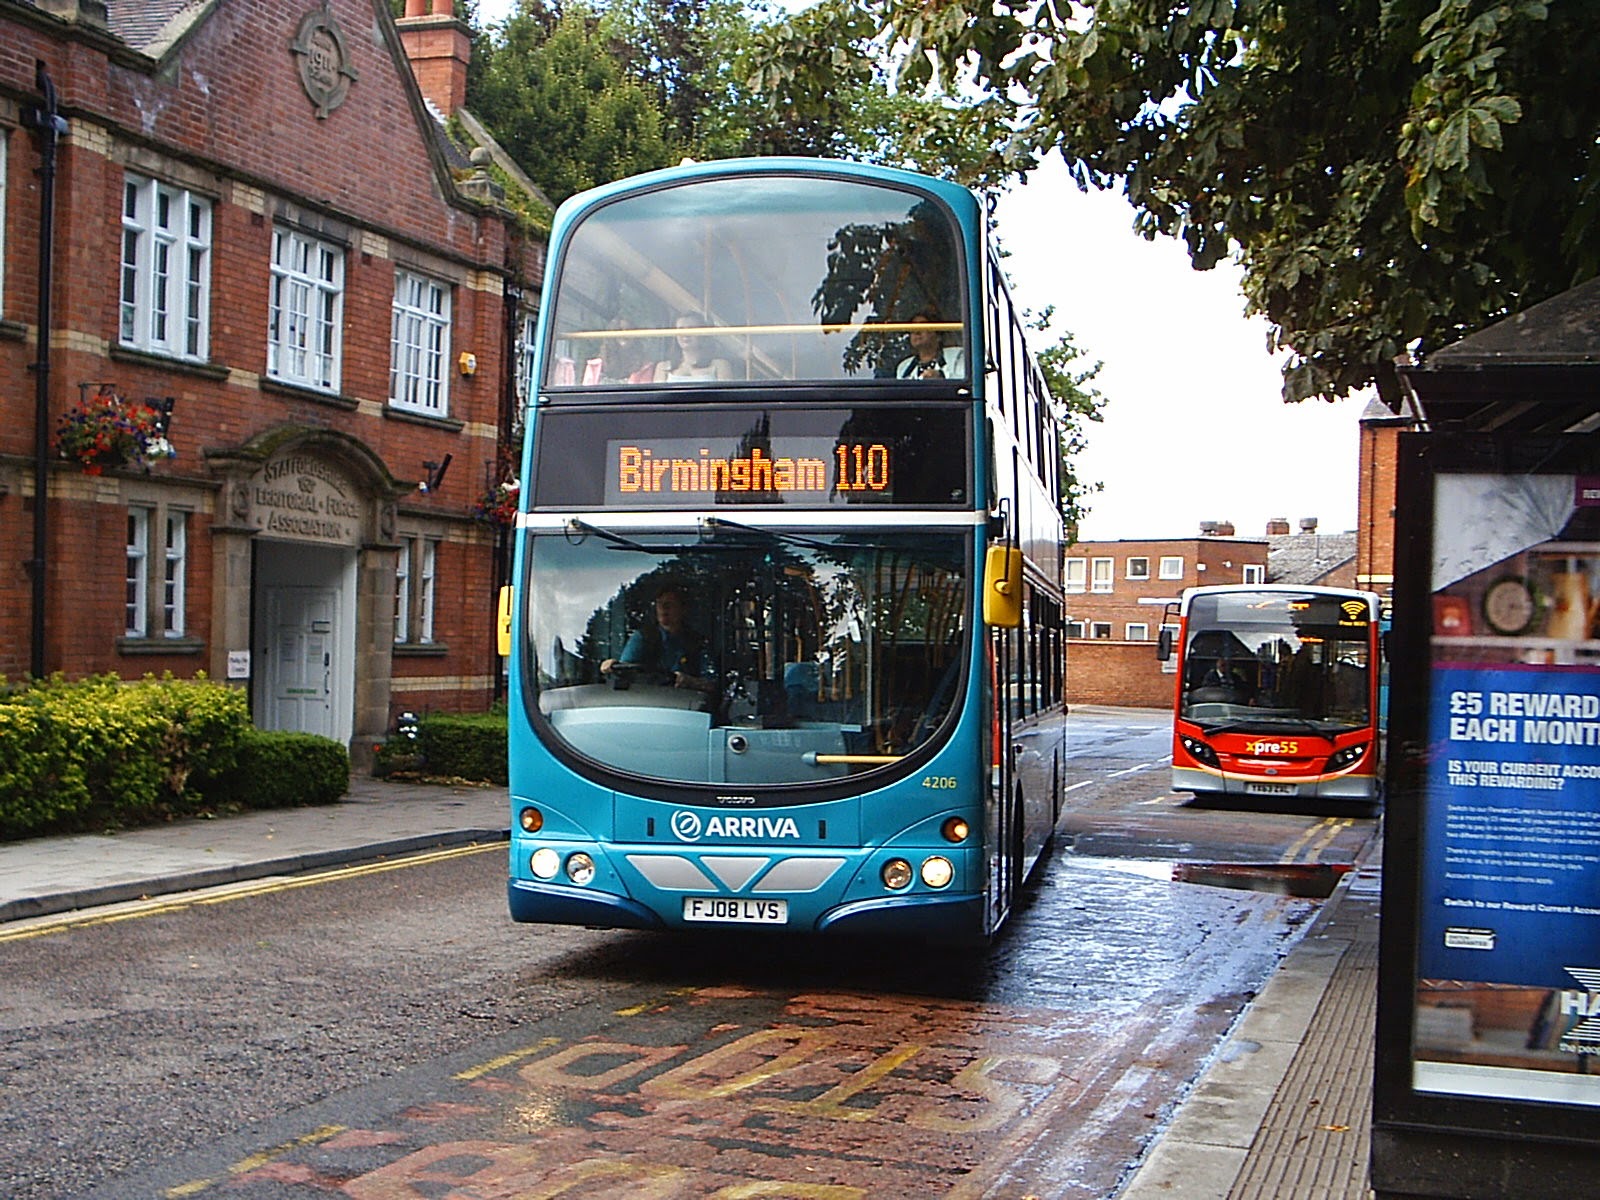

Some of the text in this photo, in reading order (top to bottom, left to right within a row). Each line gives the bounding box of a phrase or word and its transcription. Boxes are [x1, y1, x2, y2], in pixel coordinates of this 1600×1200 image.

[619, 444, 889, 492] Birmingham 110
[267, 511, 341, 539] ASSOCIATION
[1450, 691, 1599, 719] £5 REWARD
[1450, 717, 1600, 746] EACH MONT
[1246, 740, 1298, 755] xpre55
[1448, 760, 1462, 774] IS
[1464, 761, 1499, 775] YOUR
[1501, 762, 1562, 777] CURRENT
[922, 776, 957, 789] 4206
[1448, 773, 1565, 790] THIS REWARDING?
[705, 816, 800, 838] ARRIVA
[692, 900, 779, 919] FJ08 LVS
[1444, 898, 1474, 907] Switch
[1475, 900, 1485, 908] to
[1486, 901, 1501, 909] our
[1502, 901, 1536, 911] Reward
[1537, 903, 1572, 913] Current
